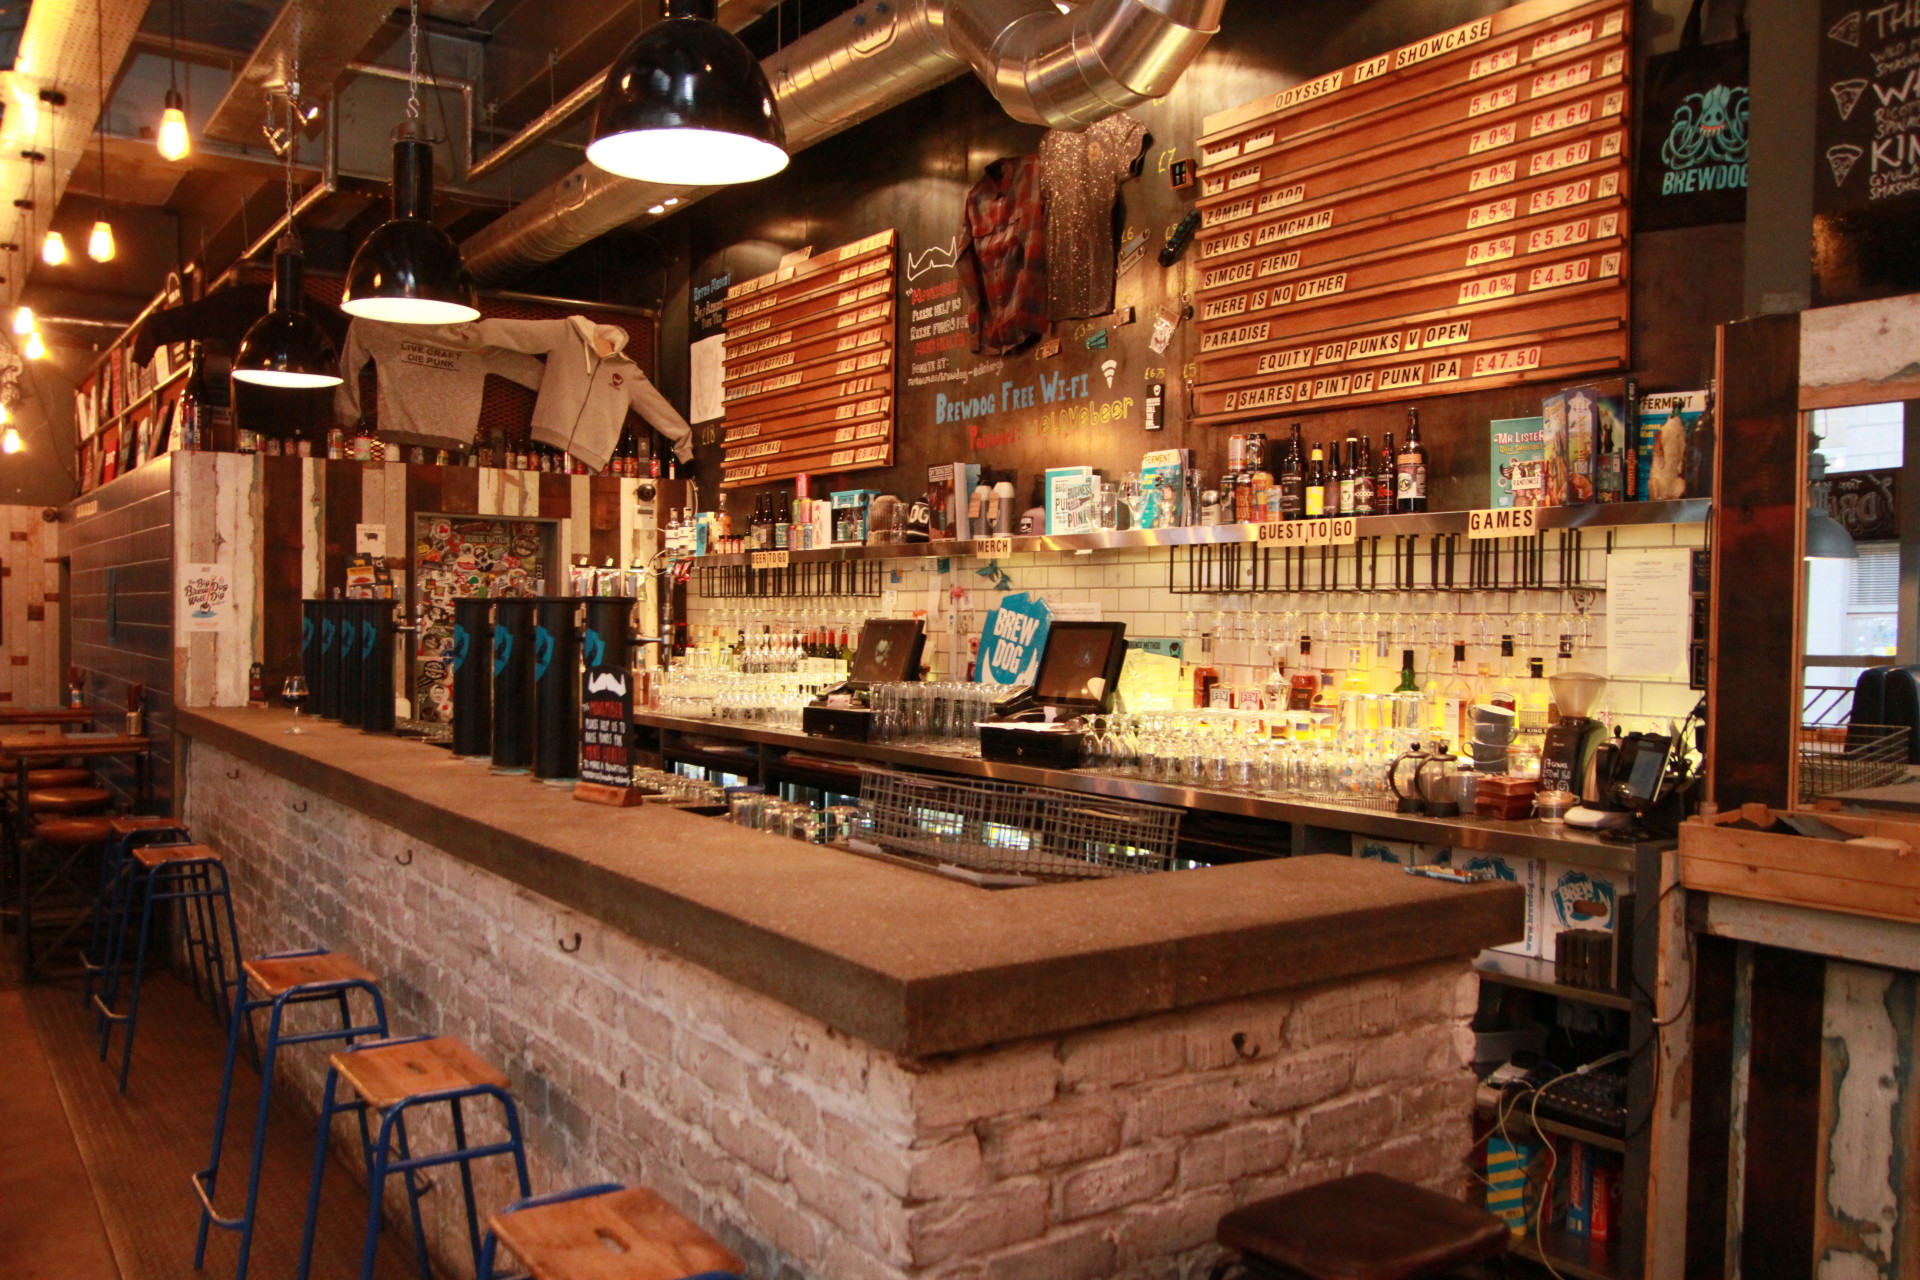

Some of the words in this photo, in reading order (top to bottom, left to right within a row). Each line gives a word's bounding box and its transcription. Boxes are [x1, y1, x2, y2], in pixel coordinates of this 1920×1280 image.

[1274, 74, 1341, 110] ODYSSEY
[1356, 57, 1388, 81] TAP
[1397, 20, 1491, 67] SHOWCASE
[1471, 48, 1517, 77] 4.6%
[1207, 177, 1223, 194] LA
[1471, 87, 1516, 114] 5.0%
[1533, 63, 1591, 96] £4.00
[1206, 199, 1254, 225] ZOMBIE
[1259, 185, 1304, 209] BLOOD
[1471, 125, 1513, 151] 7.0%
[1533, 103, 1590, 134] £4.60
[1205, 231, 1251, 256] DEVILS
[1258, 210, 1331, 243] ARMCHAIR
[1471, 164, 1513, 191] 7.0%
[1532, 144, 1589, 175] £4.60
[1205, 262, 1253, 287] SIMCOE
[1259, 252, 1299, 276] FIEND
[1469, 201, 1513, 227] 8.5%
[1531, 182, 1588, 212] £5.20
[1206, 293, 1246, 318] THERE
[1252, 291, 1267, 309] IS
[1272, 285, 1292, 305] NO
[1299, 274, 1345, 297] OTHER
[1469, 239, 1512, 262] 8.5%
[1531, 221, 1588, 249] £5.20
[934, 300, 952, 317] HELP
[1203, 323, 1268, 349] PARADISE
[1462, 277, 1513, 302] 10.0%
[1531, 260, 1588, 288] £4.50
[401, 342, 424, 354] LIVE
[426, 347, 462, 361] CRAFT
[1258, 348, 1312, 371] EQUITY
[1315, 343, 1343, 362] FOR
[1349, 333, 1400, 358] PUNKS
[1408, 329, 1420, 347] V
[1426, 322, 1470, 344] OPEN
[407, 353, 424, 363] DIE
[426, 356, 454, 368] PUNK
[1226, 392, 1236, 410] 2
[1239, 384, 1294, 407] SHARES
[1299, 381, 1310, 397] &
[1314, 375, 1349, 396] PINT
[1353, 372, 1374, 391] OF
[1380, 365, 1422, 386] PUNK
[1430, 360, 1458, 380] IPA
[1474, 347, 1539, 375] £47.50
[935, 392, 996, 425] BREWDOG
[1001, 380, 1036, 412] FREE
[1039, 370, 1090, 404] WI-FI
[726, 427, 744, 442] ELVIS
[744, 423, 761, 438] JUICE
[1498, 433, 1513, 446] MR
[745, 441, 780, 458] CHRISTMAS
[725, 466, 756, 481] ABSTRAKT
[757, 464, 767, 477] 24
[1512, 477, 1541, 488] RANDOMISE
[1259, 523, 1304, 541] GUEST
[1308, 521, 1328, 538] TO
[1333, 520, 1353, 536] GO
[1471, 508, 1533, 531] GAMES
[977, 539, 1009, 553] MERCH
[752, 551, 767, 565] BEER
[768, 552, 778, 564] TO
[777, 551, 787, 563] GO
[184, 585, 209, 597] Brew
[210, 581, 229, 592] Dog
[196, 578, 210, 588] Big
[188, 593, 206, 606] Well
[210, 591, 225, 602] Dig
[993, 607, 1040, 647] BREW
[991, 638, 1024, 674] DOG
[1525, 859, 1534, 952] www.brewdog.com
